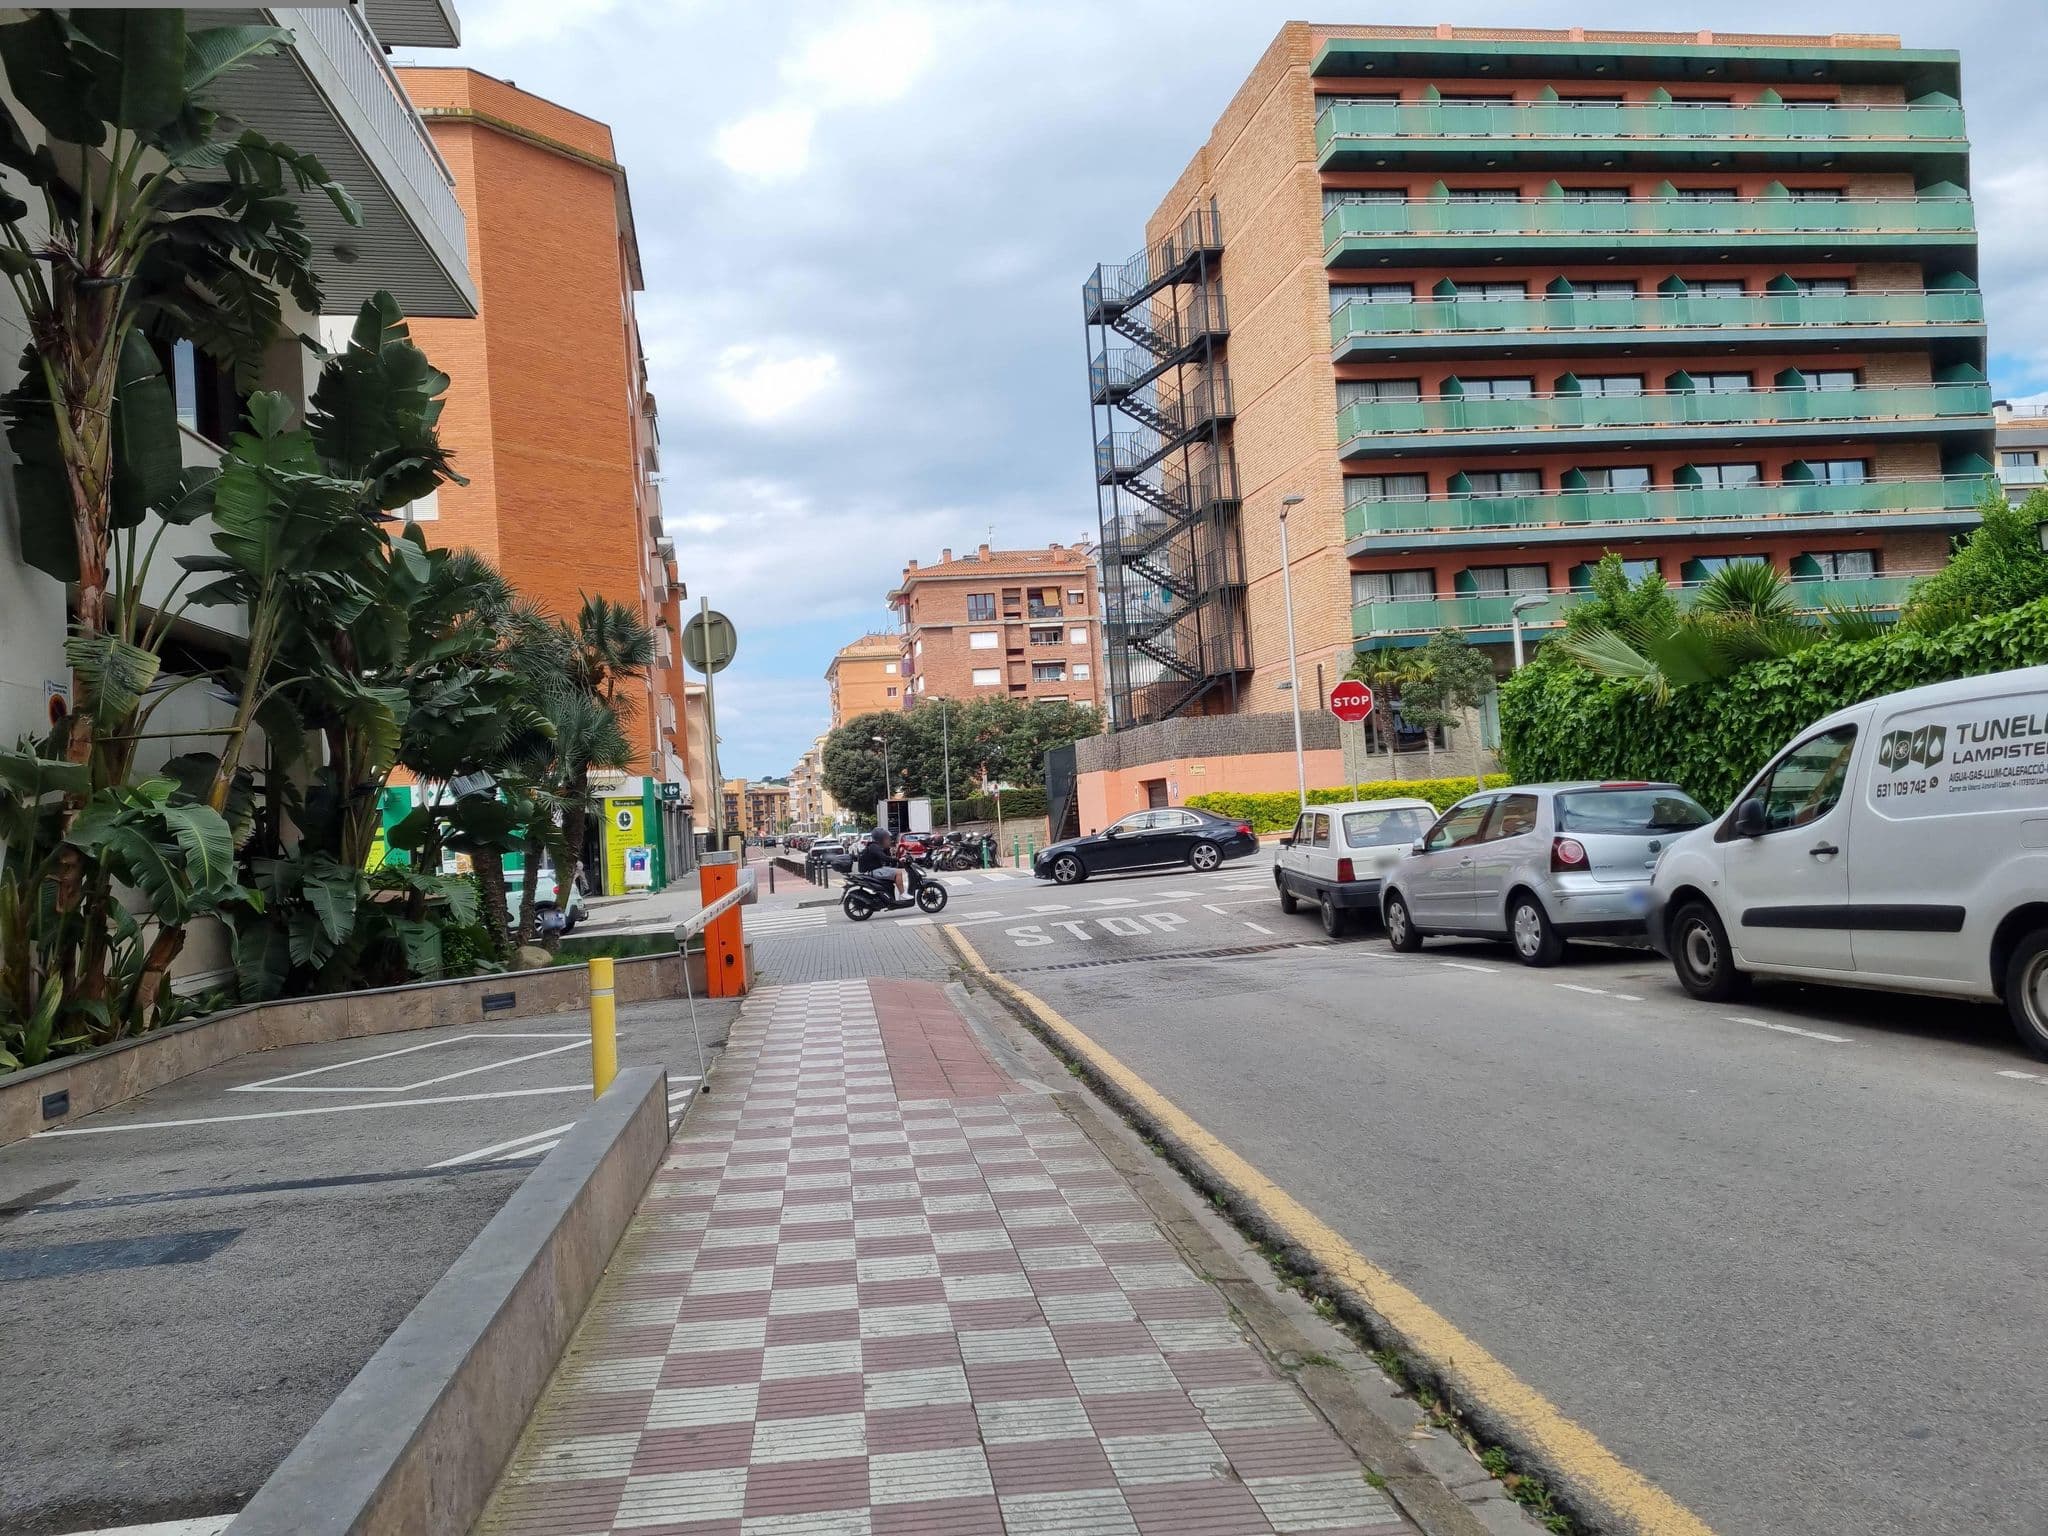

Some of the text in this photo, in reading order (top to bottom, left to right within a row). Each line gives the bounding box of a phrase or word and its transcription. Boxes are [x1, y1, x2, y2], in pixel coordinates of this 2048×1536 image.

[1333, 695, 1369, 707] STOP
[1953, 741, 2048, 764] LAMPISTE
[1877, 779, 1926, 798] 631 109 742
[1005, 912, 1190, 947] STOP
